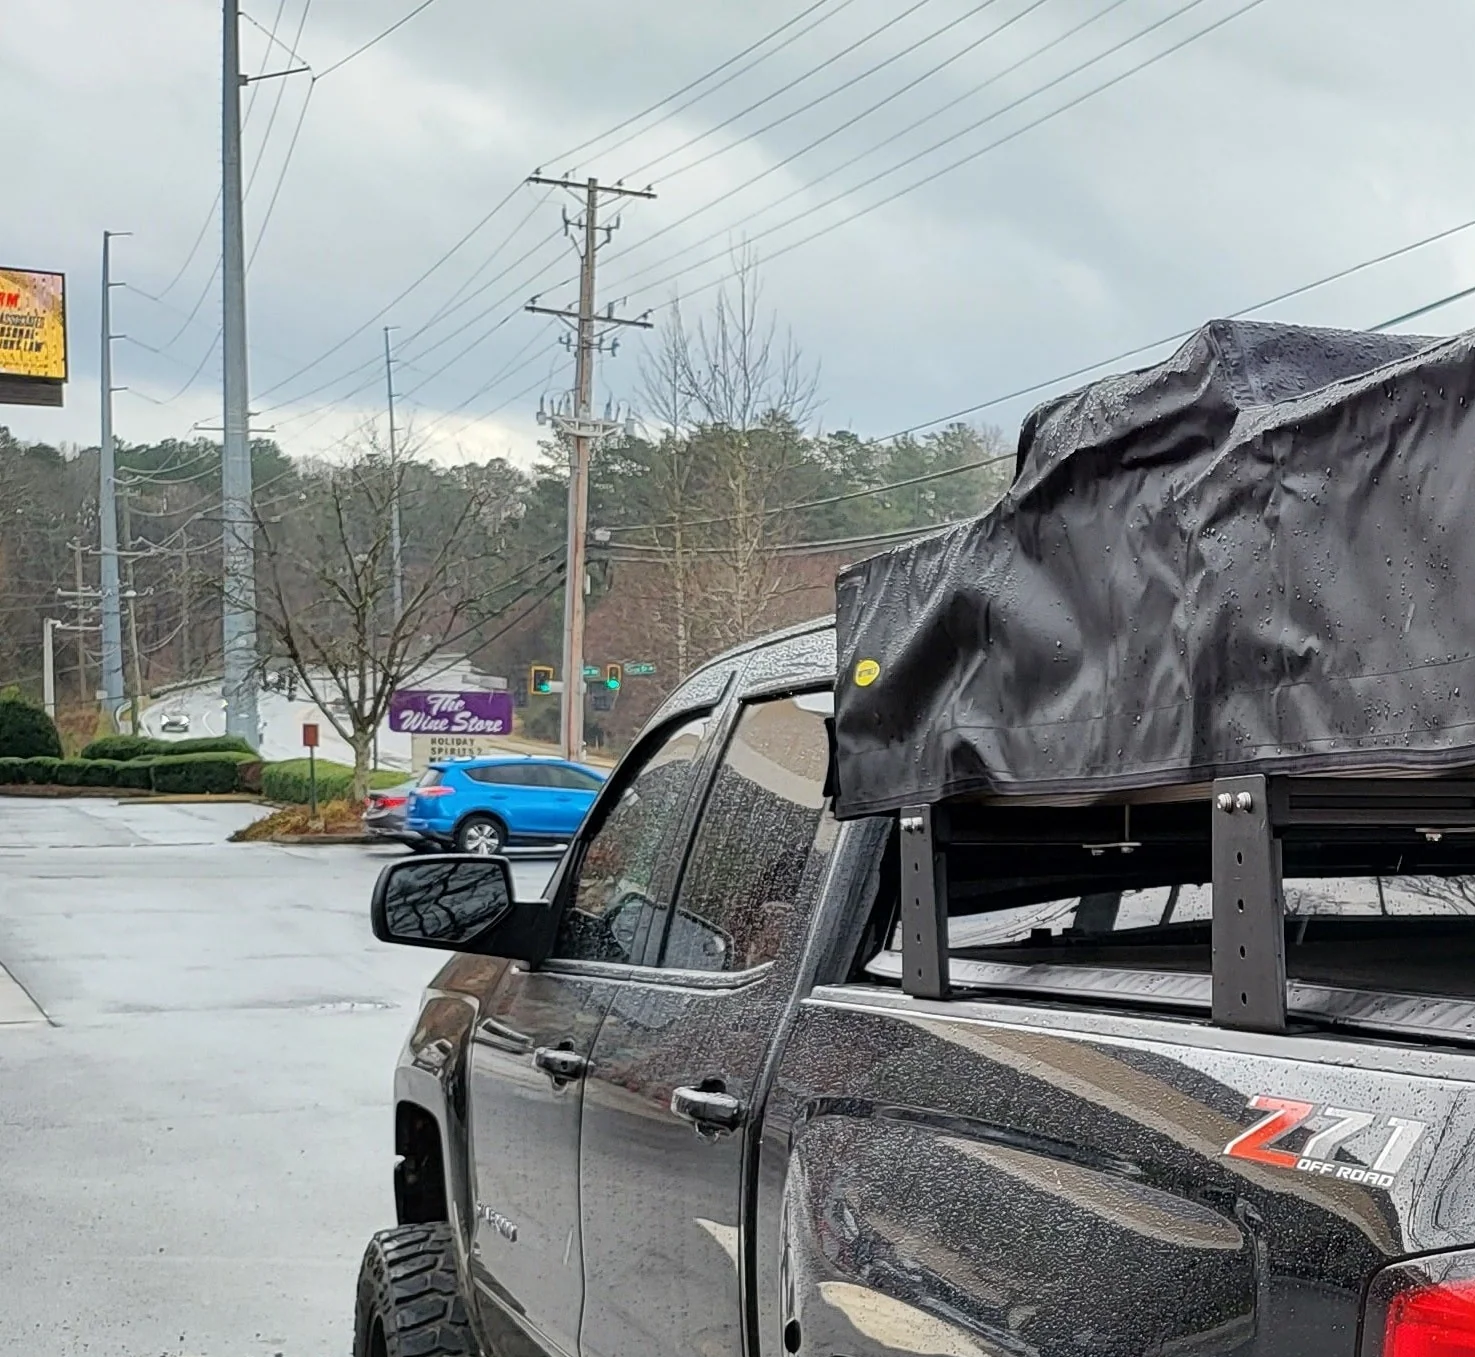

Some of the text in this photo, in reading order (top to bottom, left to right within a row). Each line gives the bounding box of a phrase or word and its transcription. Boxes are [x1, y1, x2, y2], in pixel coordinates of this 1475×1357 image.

[426, 693, 465, 716] The
[399, 709, 504, 733] Wine Store
[430, 737, 475, 746] HOLIDAY
[1223, 1094, 1427, 1173] Z71
[1296, 1157, 1395, 1187] OFF ROAD
